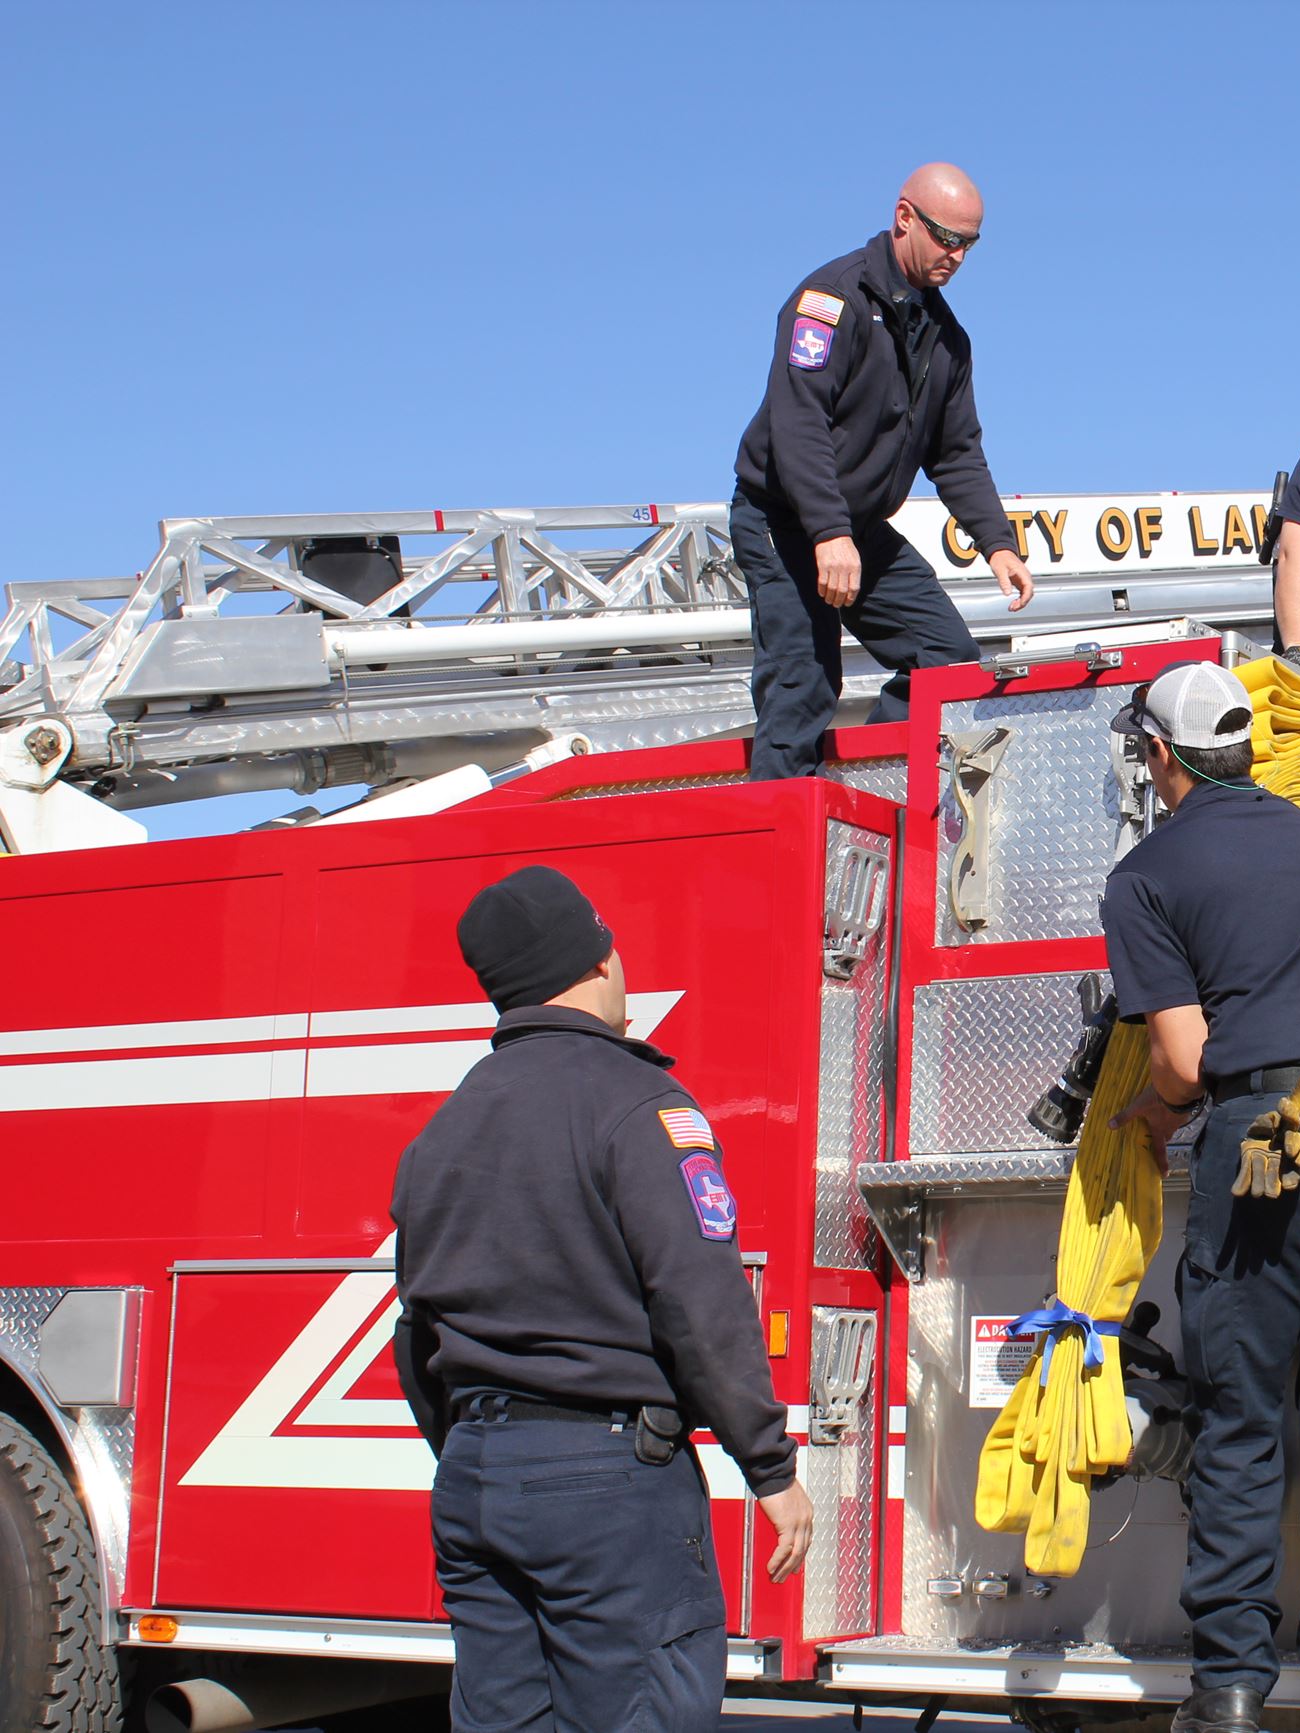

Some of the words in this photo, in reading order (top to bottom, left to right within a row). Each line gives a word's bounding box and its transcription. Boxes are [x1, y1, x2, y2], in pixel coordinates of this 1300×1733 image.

[633, 508, 650, 520] 45
[942, 509, 1068, 568] CTY
[1096, 506, 1163, 561] OF
